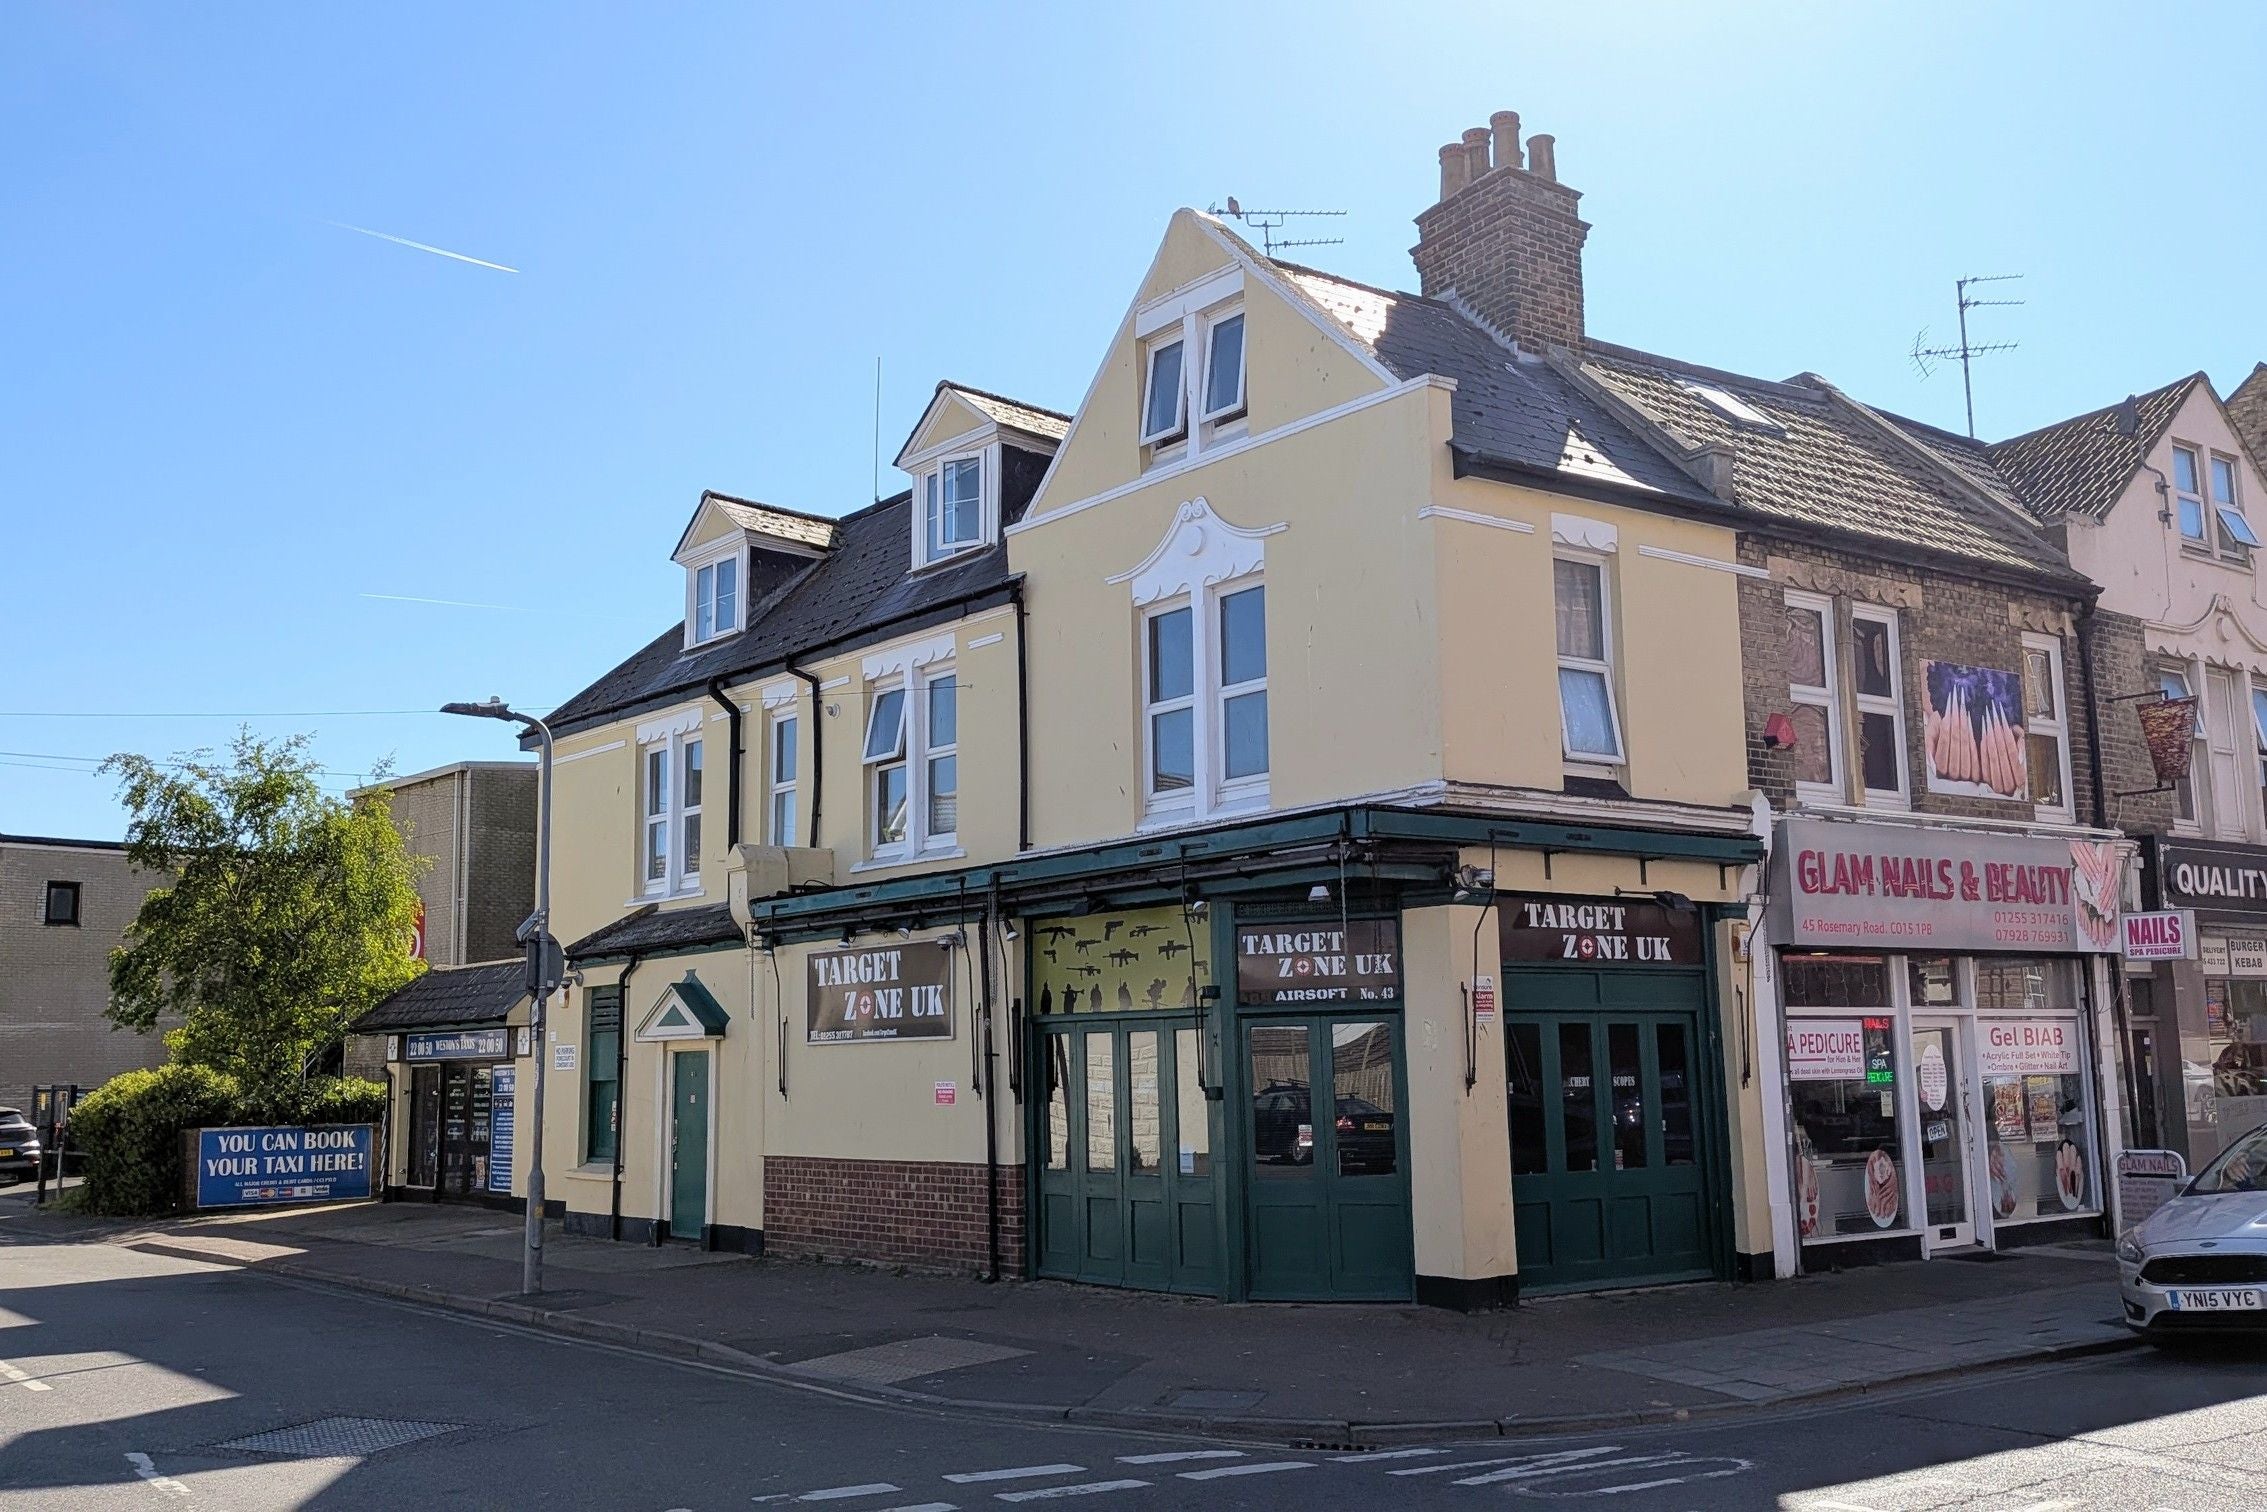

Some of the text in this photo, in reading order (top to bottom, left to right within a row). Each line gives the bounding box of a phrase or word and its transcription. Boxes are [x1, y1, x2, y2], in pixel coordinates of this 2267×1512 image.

[1798, 850, 2070, 905] GLAM NAILS & BEAUTY
[1524, 903, 1625, 930] TARGET
[1994, 911, 2068, 925] 01255 317416
[1803, 919, 1814, 932] 45
[1817, 920, 1860, 936] Rosemary
[1891, 922, 1913, 935] CO15
[1917, 923, 1932, 935] 1PB
[1995, 929, 2029, 941] 07928
[2127, 916, 2181, 945] NAILS
[1242, 931, 1343, 955] TARGET
[1562, 934, 1672, 960] ZONE UK
[2130, 946, 2182, 956] SPA PEDICURE
[2230, 940, 2264, 951] BURGER
[814, 950, 901, 987] TARGET
[1278, 953, 1393, 978] ZONE UK
[2235, 957, 2263, 968] KEBAB
[844, 984, 945, 1021] ZONE UK
[1275, 987, 1394, 1002] AIRSOFT No. 43
[1800, 1033, 1860, 1054] PEDICURE
[1990, 1026, 2064, 1046] Gel BIAB
[410, 1042, 417, 1056] 22
[479, 1039, 486, 1053] 22
[1986, 1052, 2009, 1061] Acrylic
[2025, 1051, 2036, 1059] Set
[2041, 1051, 2059, 1059] White
[2061, 1050, 2071, 1059] Tip
[1872, 1059, 1887, 1069] SPA
[1991, 1063, 2013, 1071] Ombre
[2019, 1062, 2039, 1070] Glitter
[2044, 1062, 2056, 1070] Nail
[1612, 1076, 1635, 1087] SCOPES
[218, 1130, 355, 1153] YOU CAN BOOK
[207, 1152, 364, 1177] YOUR TAXI HERE!
[2120, 1158, 2178, 1172] GLAM NAILS
[2183, 1292, 2218, 1308] YN15
